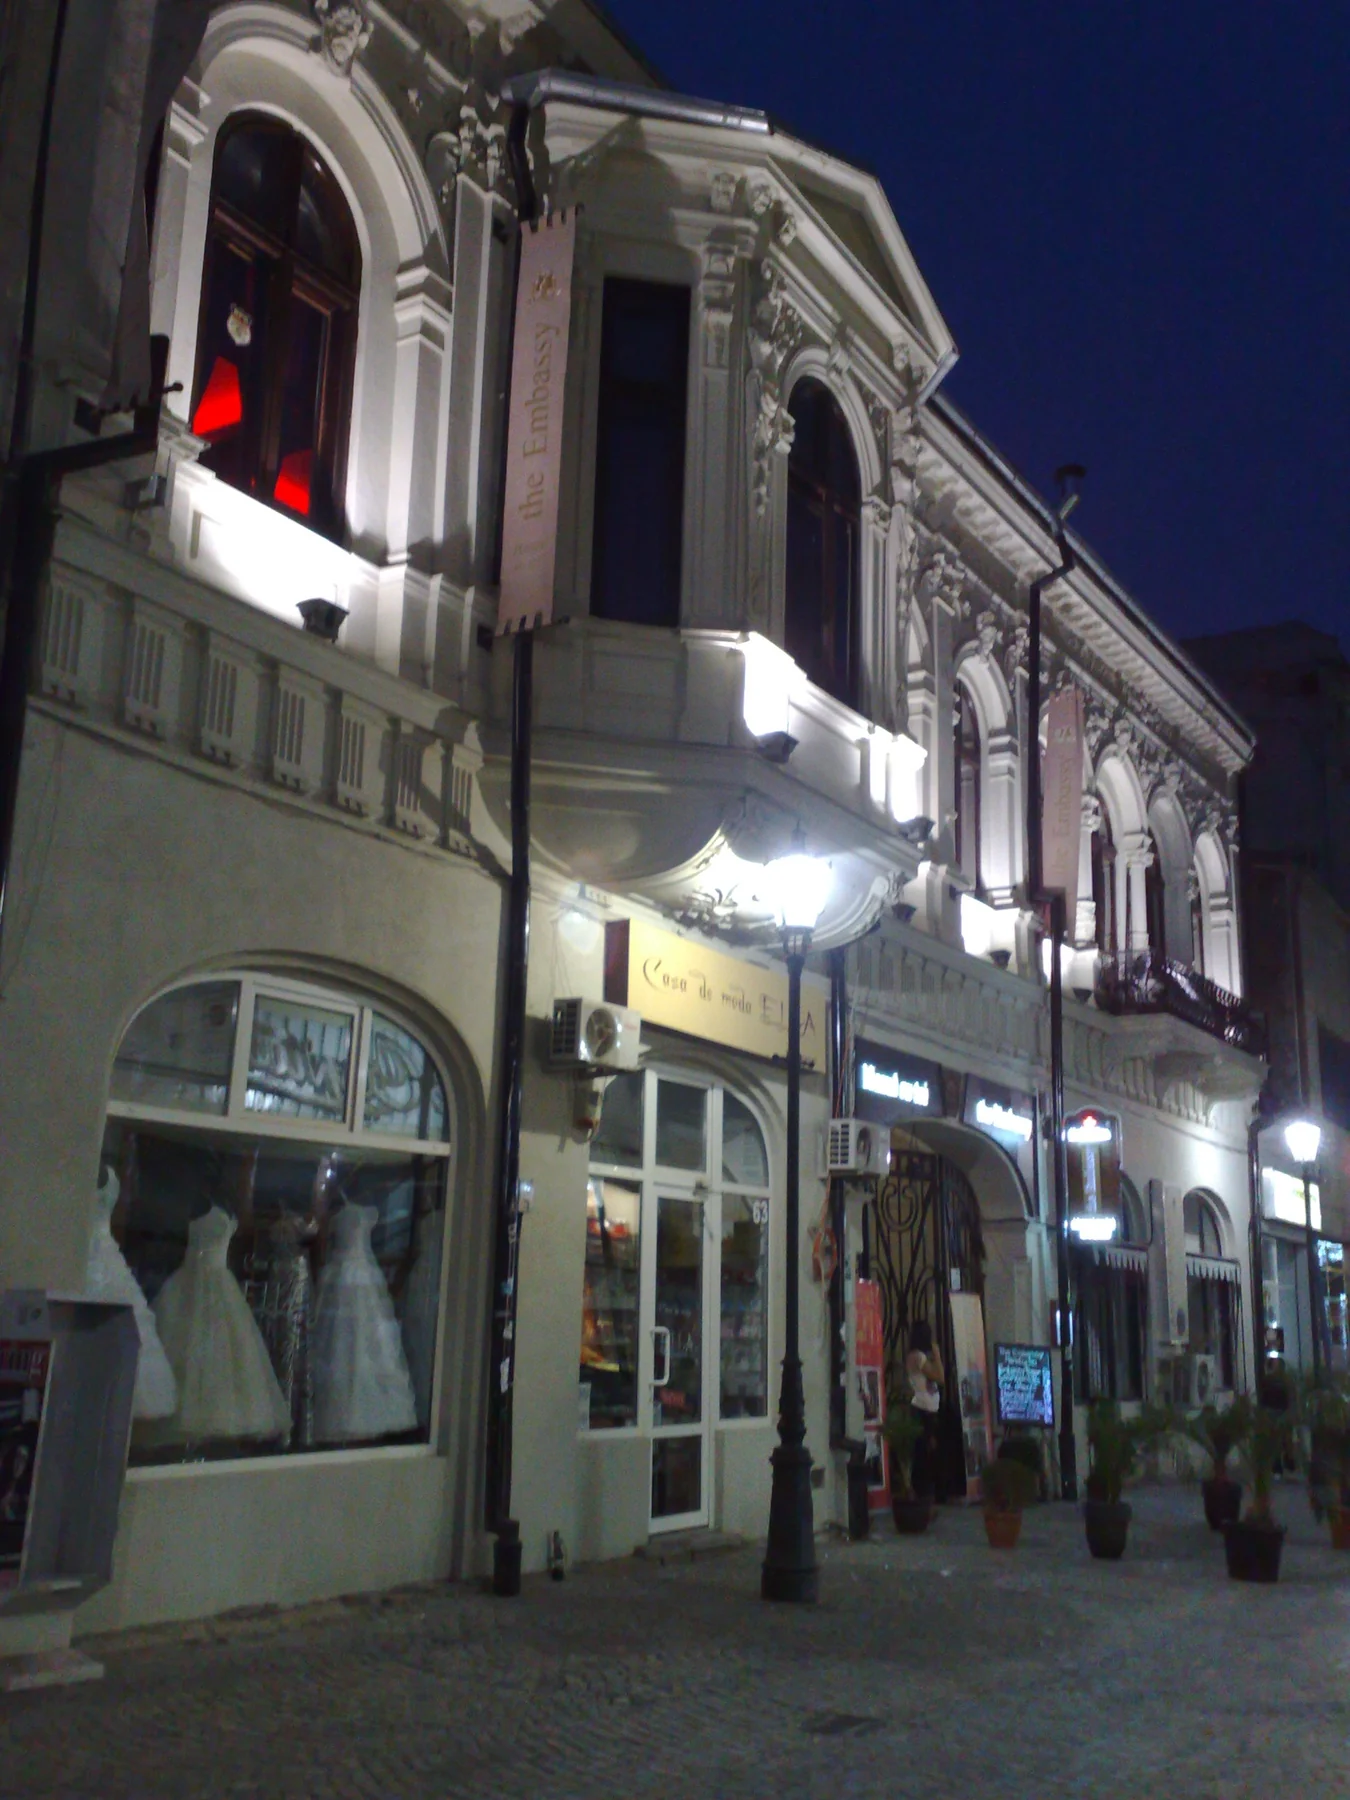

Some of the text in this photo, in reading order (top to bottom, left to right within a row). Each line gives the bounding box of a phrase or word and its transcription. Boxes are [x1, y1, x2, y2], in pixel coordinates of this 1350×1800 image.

[523, 323, 560, 457] Embassy
[518, 473, 545, 520] the
[642, 957, 687, 993] Casa
[690, 970, 713, 1002] de
[760, 993, 816, 1037] ELA
[753, 1199, 768, 1224] 63
